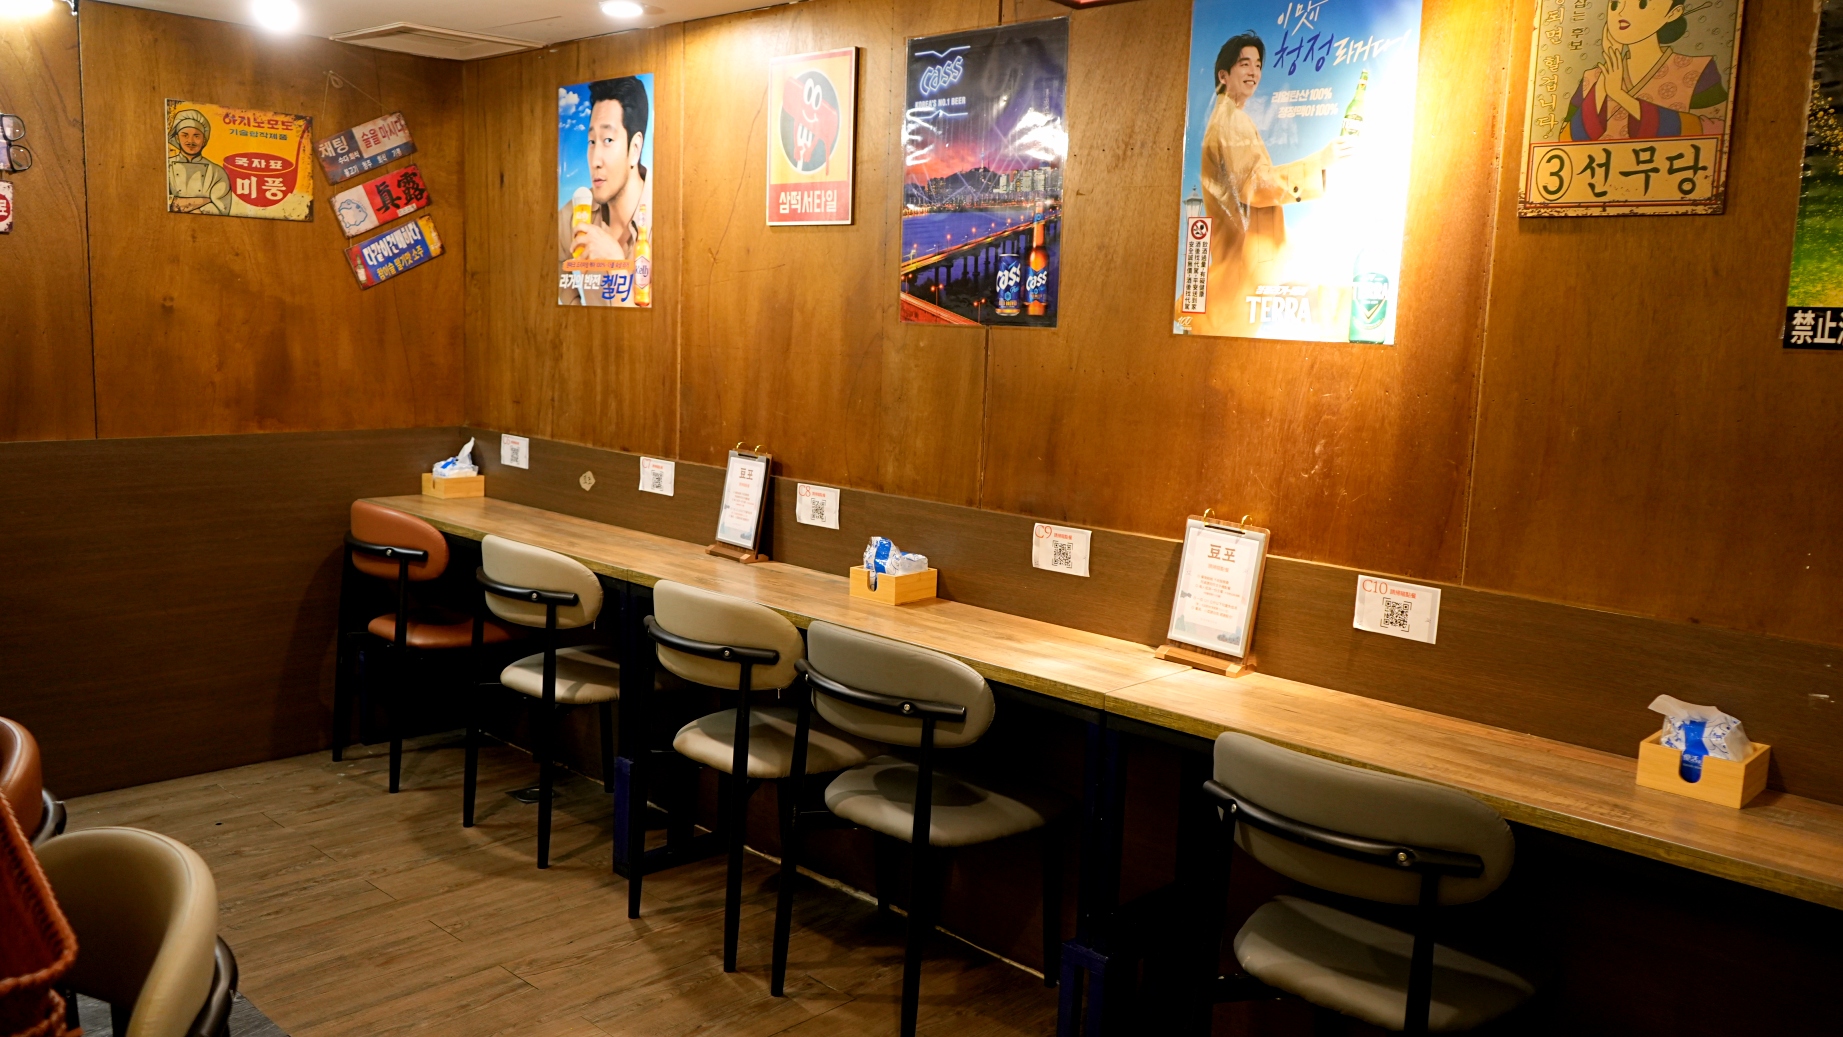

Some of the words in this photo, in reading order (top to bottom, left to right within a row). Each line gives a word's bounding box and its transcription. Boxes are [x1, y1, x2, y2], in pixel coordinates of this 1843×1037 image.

[1570, 27, 1585, 51] 후보
[915, 98, 937, 109] KOREA'S
[951, 96, 966, 106] BEER
[1309, 87, 1333, 101] 100%
[1315, 103, 1339, 116] 100%
[222, 112, 295, 131] 아지노모도
[319, 136, 349, 158] 채팅
[235, 157, 283, 169] 국자표
[1577, 144, 1708, 198] 선무당
[236, 176, 287, 200] 미풍
[779, 189, 837, 214] 삼떡서타일
[559, 273, 583, 289] 라거의
[583, 274, 602, 290] 반전
[600, 273, 634, 302] 켈리
[1245, 295, 1314, 324] TERRA
[1790, 309, 1843, 345] 禁止
[798, 484, 811, 497] C8
[1035, 524, 1053, 539] C9
[1362, 579, 1388, 595] C10
